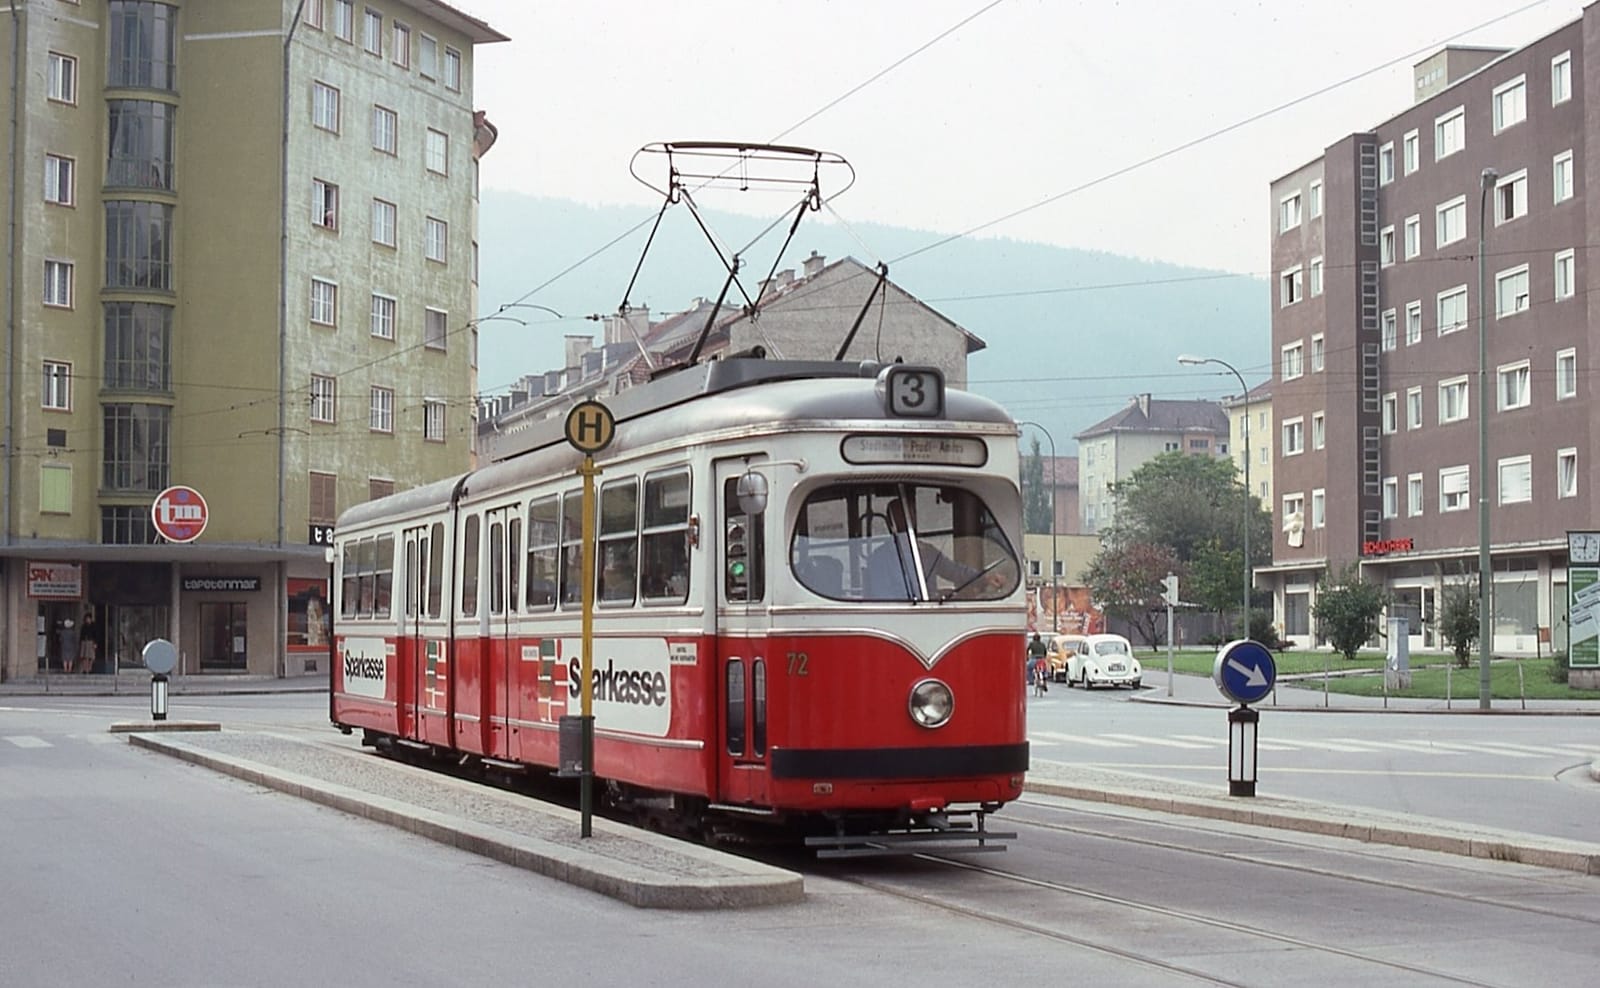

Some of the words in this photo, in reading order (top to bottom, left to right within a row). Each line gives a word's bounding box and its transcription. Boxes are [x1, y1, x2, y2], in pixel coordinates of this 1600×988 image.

[902, 374, 925, 408] 3
[578, 411, 602, 443] H
[344, 649, 384, 683] Sparkasse
[569, 657, 666, 706] Sarkasse
[787, 653, 808, 676] 72
